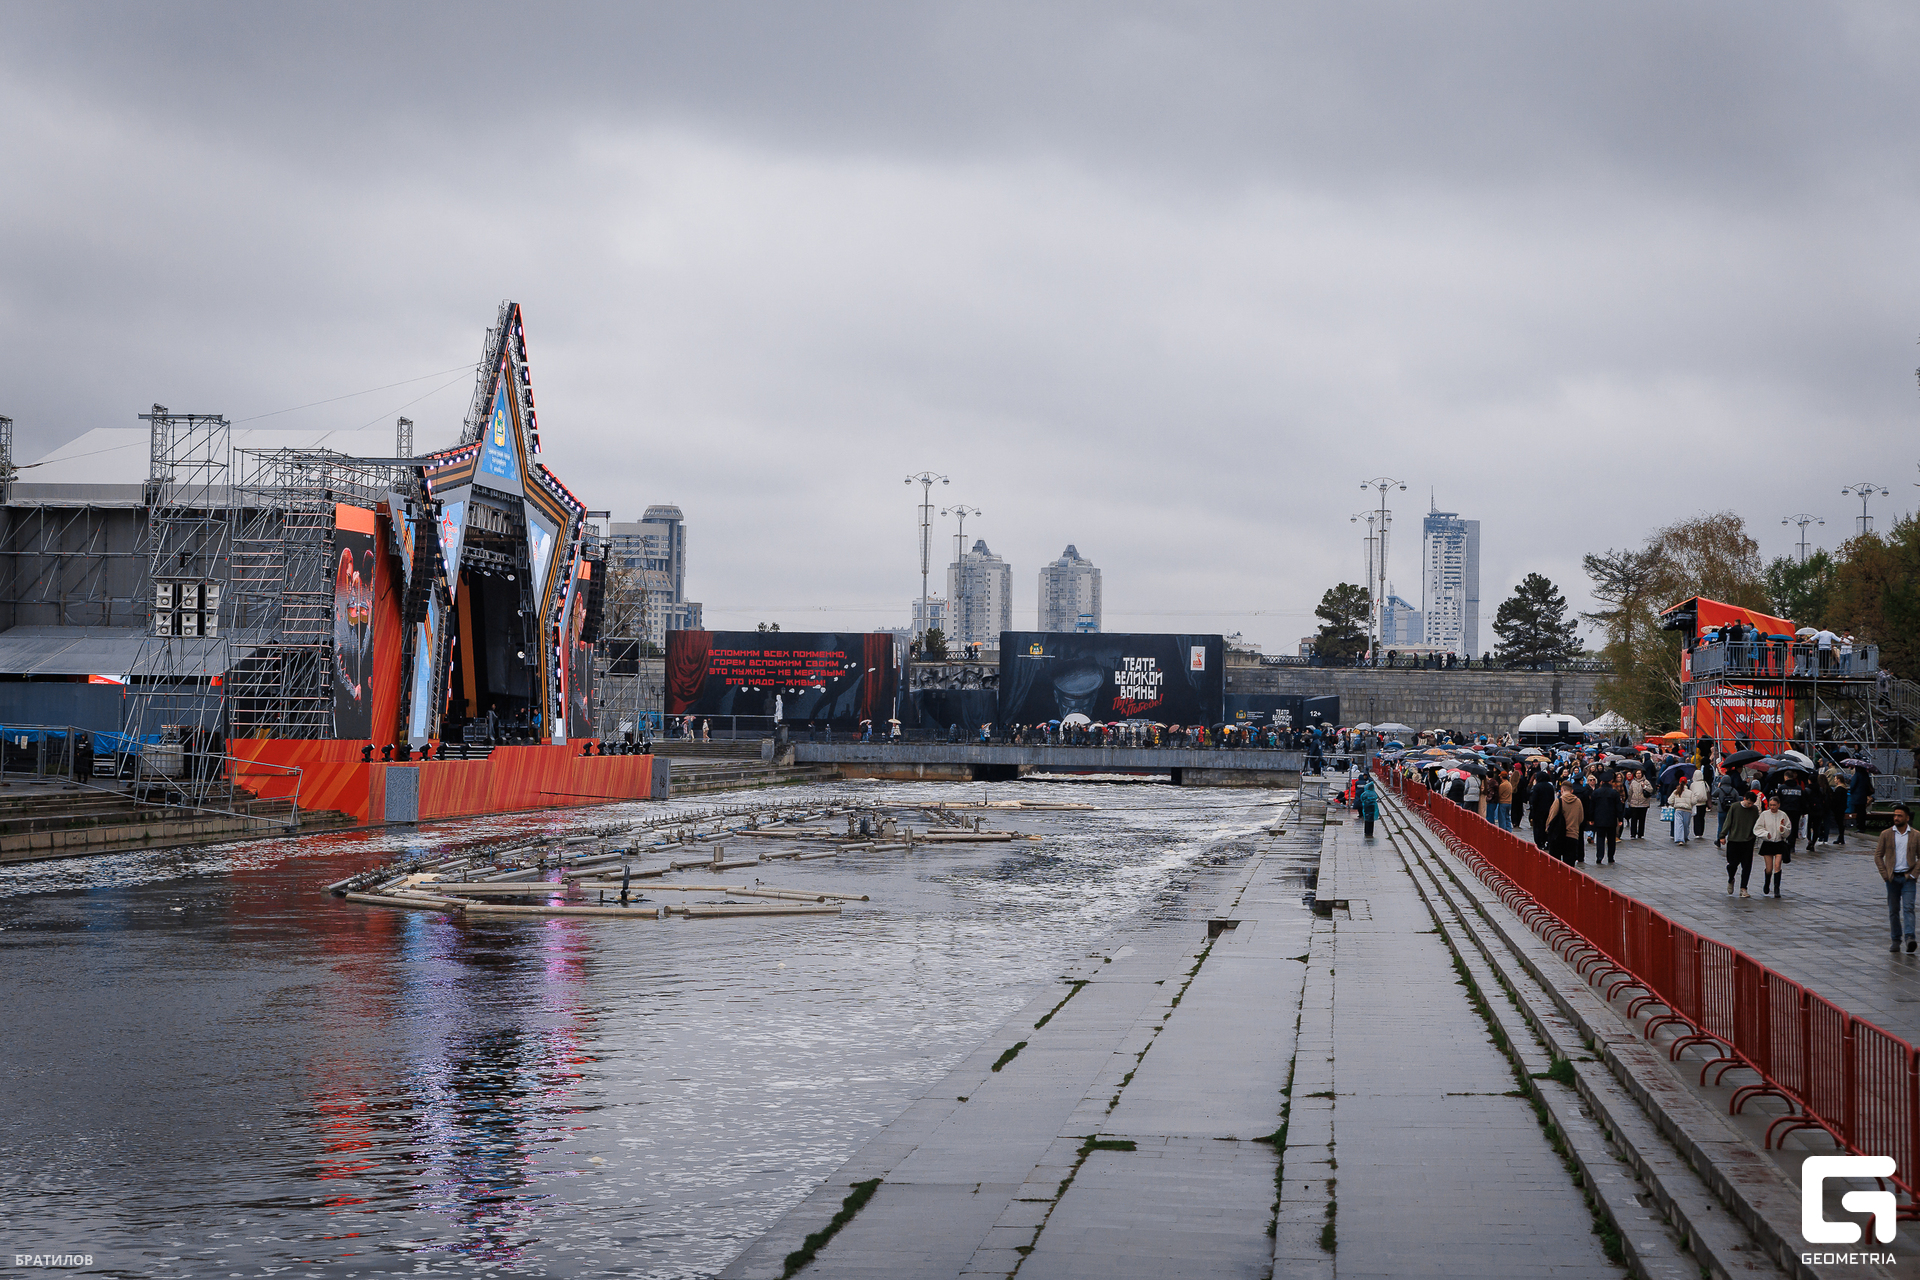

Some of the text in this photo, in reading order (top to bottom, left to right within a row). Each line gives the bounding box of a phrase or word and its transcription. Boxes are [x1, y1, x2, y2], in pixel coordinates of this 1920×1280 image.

[708, 649, 848, 660] ВСПОМНИМ ВСЕХ ПОИМЕННО,
[713, 658, 746, 666] ГОРЕМ
[749, 659, 802, 667] ВСПОМНИМ
[1122, 657, 1156, 671] ТЕАТР
[708, 667, 728, 675] ЭТО
[731, 668, 766, 676] НУЖНО
[793, 669, 846, 677] МЕРТВЫМ!
[1114, 669, 1163, 685] ВЕЛИКОЙ
[748, 678, 775, 686] НАДО
[785, 678, 826, 687] ЖИВЫМ!
[1120, 685, 1157, 700] ВОЙНЫ
